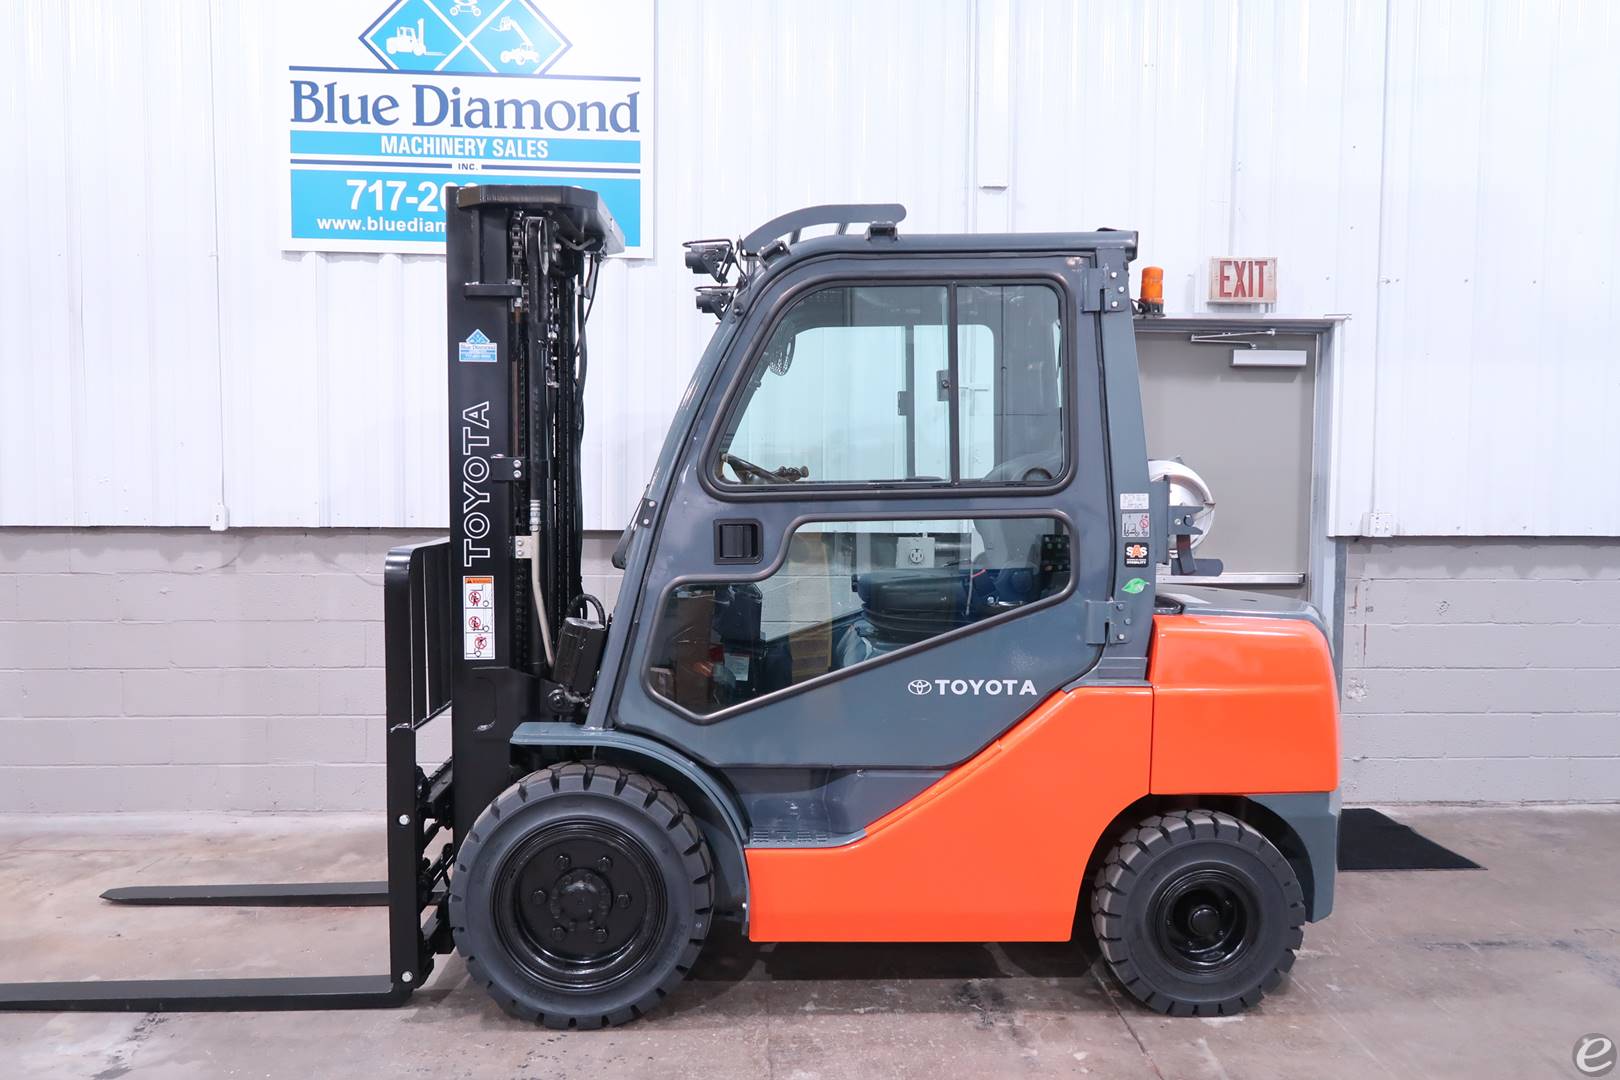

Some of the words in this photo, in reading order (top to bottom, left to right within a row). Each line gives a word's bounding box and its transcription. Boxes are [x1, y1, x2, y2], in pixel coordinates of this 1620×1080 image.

[290, 80, 399, 126] Blue
[412, 84, 640, 133] Diamond
[381, 135, 486, 158] MACHINERY
[492, 138, 549, 159] SALES
[457, 163, 478, 171] INC.
[1219, 260, 1268, 298] EXIT
[462, 400, 491, 568] TOYOTA
[1126, 544, 1147, 558] SAS
[934, 679, 1038, 696] TOYOTA
